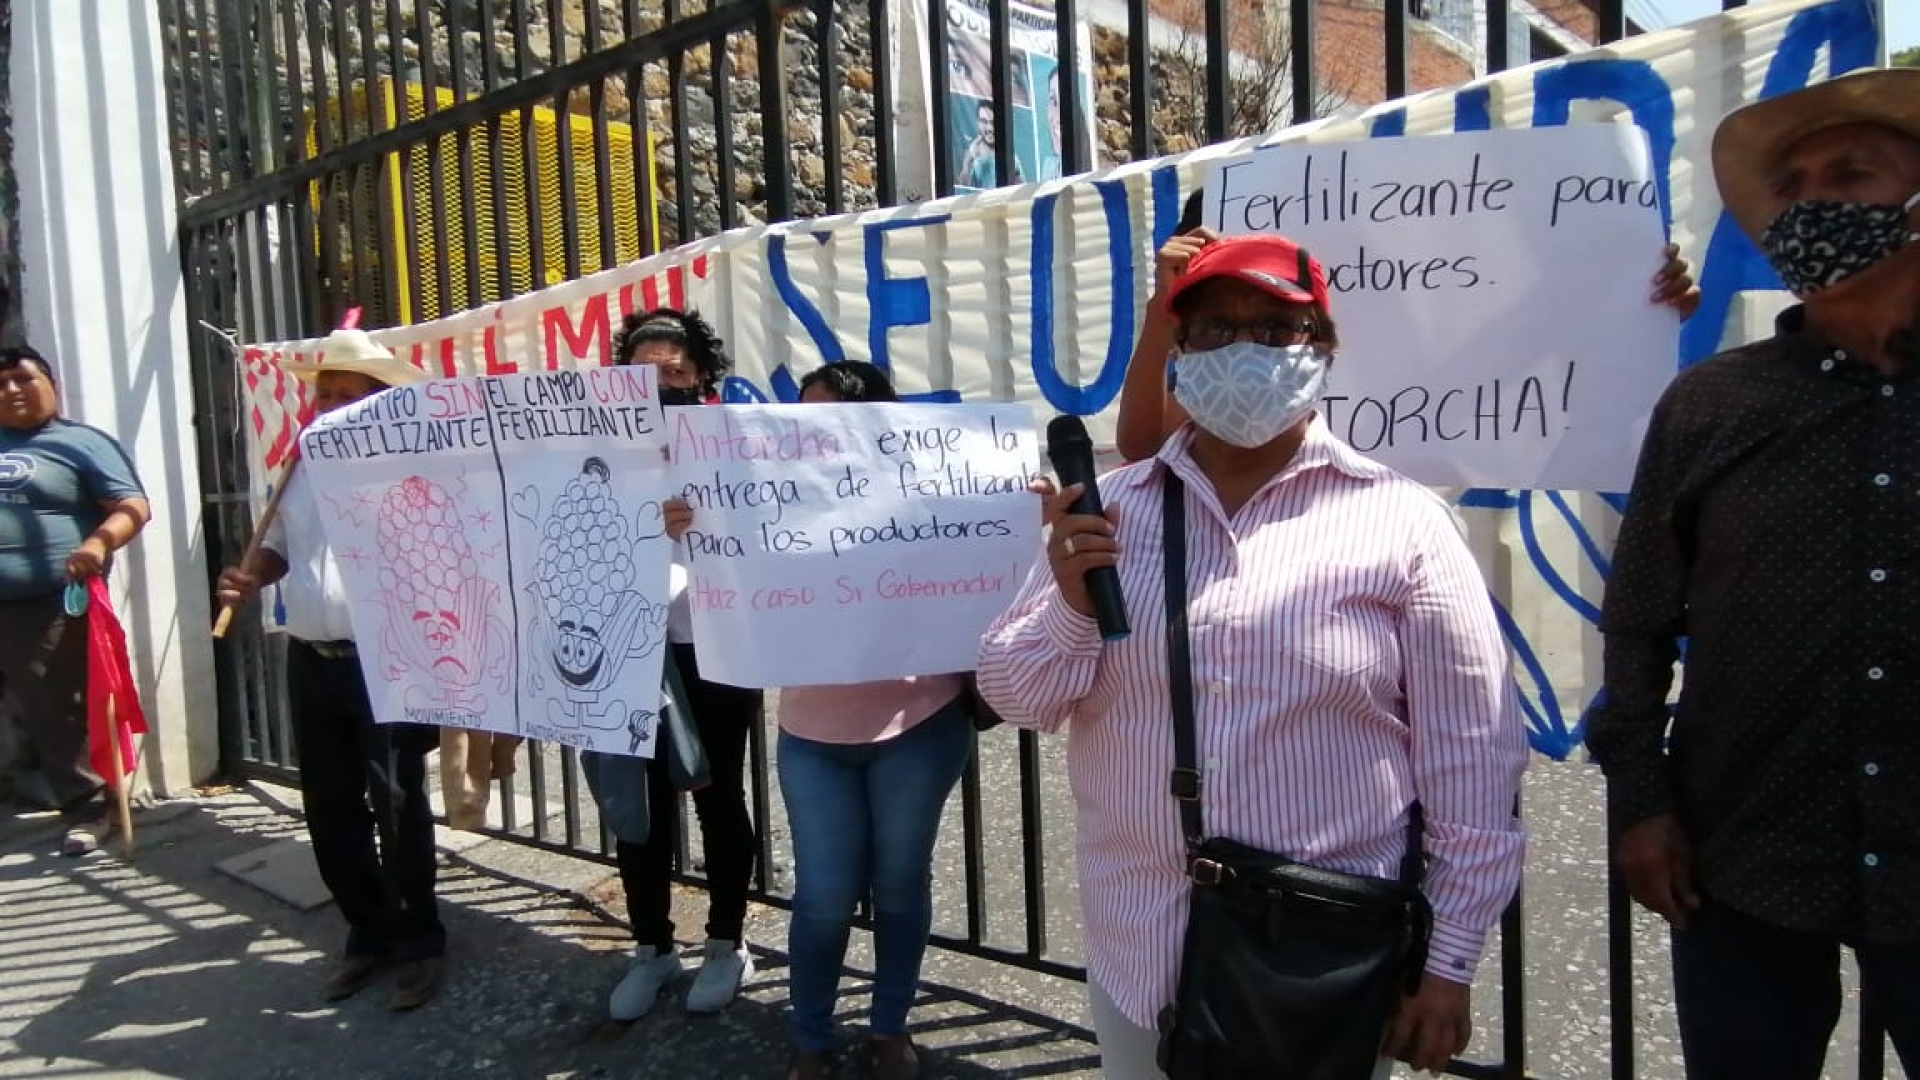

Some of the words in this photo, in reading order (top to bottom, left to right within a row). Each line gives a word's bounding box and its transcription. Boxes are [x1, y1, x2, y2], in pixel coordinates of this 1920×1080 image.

[1216, 150, 1514, 233] Fertilizante
[1550, 172, 1659, 227] para
[425, 381, 486, 419] SIN
[487, 378, 516, 409] EL
[524, 371, 586, 404] CAMPO
[590, 367, 648, 403] CON
[1321, 360, 1576, 452] TORCHA!
[305, 416, 489, 461] FERTILIZANTE
[499, 406, 653, 442] FERILIZANTE
[877, 426, 962, 468] exige
[991, 415, 1019, 450] la
[681, 470, 800, 524] entrega
[836, 466, 870, 499] de
[686, 527, 745, 562] para
[762, 525, 812, 553] los
[829, 515, 1020, 558] productores.
[751, 583, 814, 610] caso
